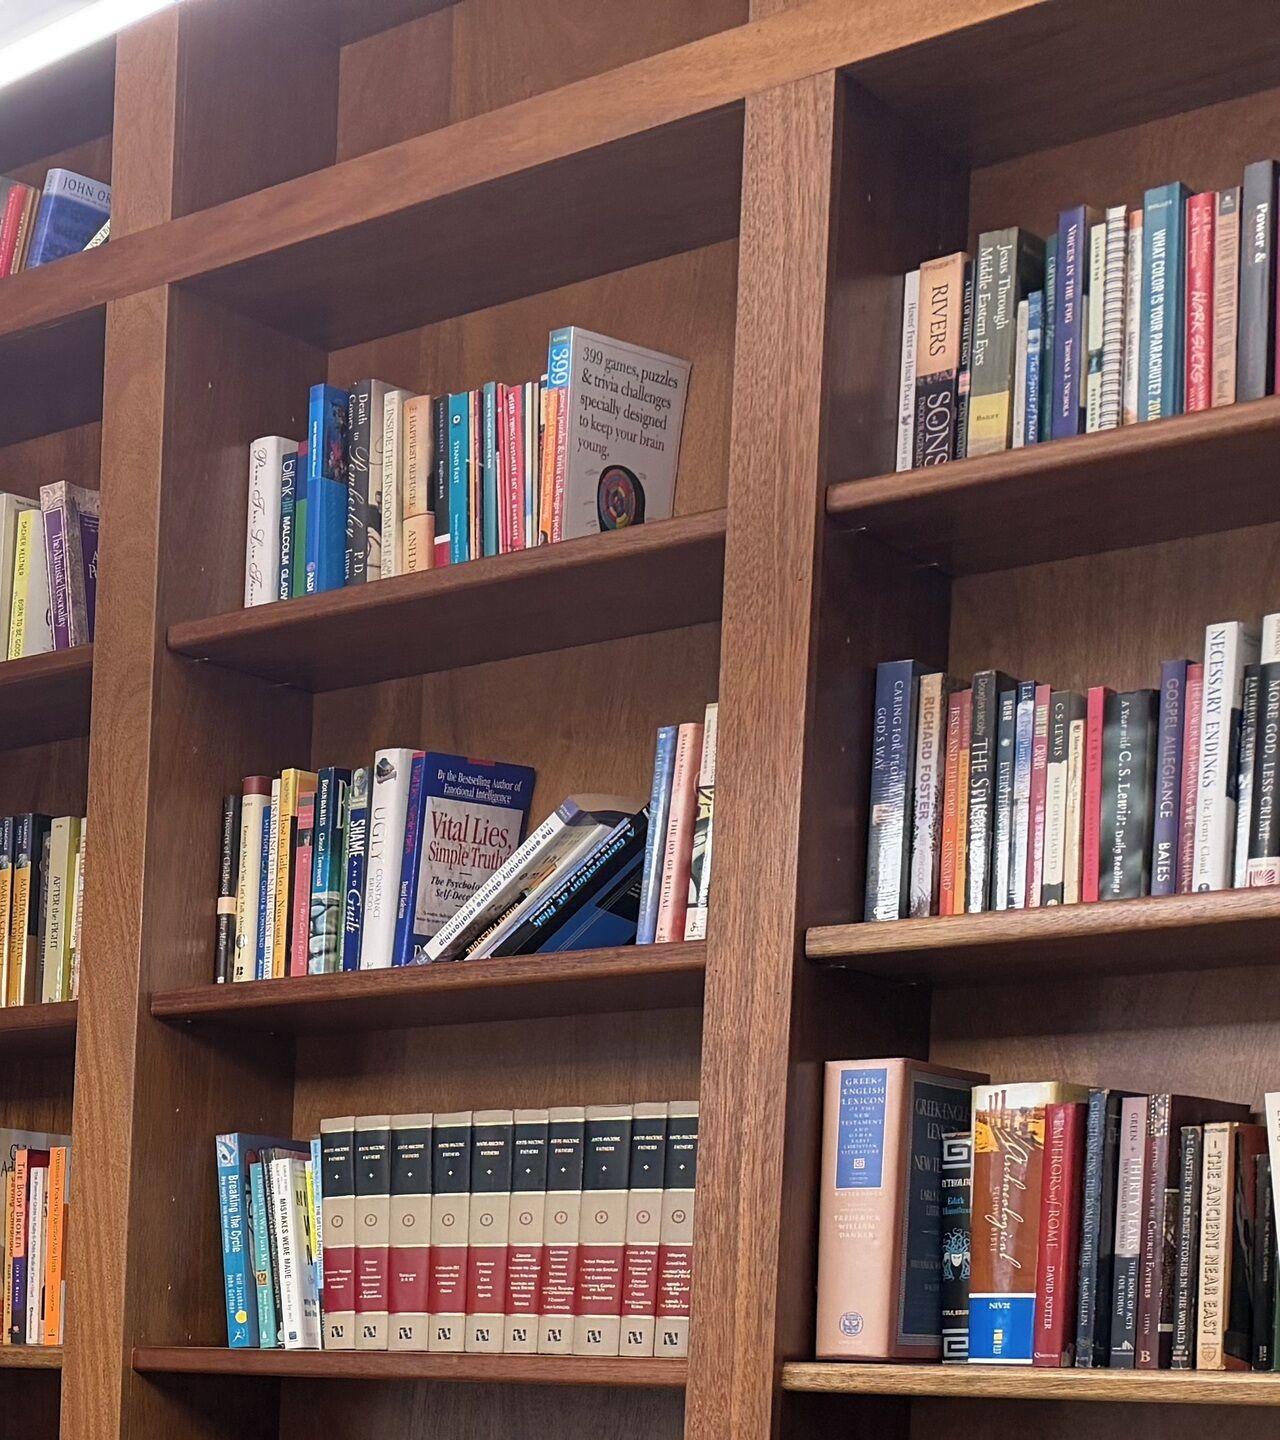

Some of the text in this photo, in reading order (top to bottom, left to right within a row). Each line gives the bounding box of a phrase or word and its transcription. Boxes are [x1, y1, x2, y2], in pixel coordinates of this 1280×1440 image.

[973, 247, 994, 366] Middle Eastern Eyes
[993, 244, 1013, 330] Jesus Through
[930, 283, 948, 357] RIVERS
[551, 348, 568, 385] 399
[583, 347, 678, 389] 399 games, puzzles
[580, 393, 667, 430] specially designed
[582, 368, 671, 411] & trivia challenges
[577, 437, 610, 460] young.
[579, 414, 664, 451] to keep your brain
[924, 391, 951, 467] SONS
[281, 459, 295, 565] blink MALCOLM
[1202, 629, 1226, 788] NECESSARY ENDINGS
[1266, 680, 1280, 719] MORE
[919, 696, 935, 821] RICHARD FOSTER
[1261, 762, 1275, 792] LESS
[349, 819, 365, 858] SHAME
[371, 807, 386, 860] UGLY
[432, 810, 512, 855] Vital Lies,
[1258, 796, 1272, 841] CRIME
[428, 840, 470, 871] Simple
[346, 889, 361, 934] Guilt
[228, 1175, 241, 1253] Breaking the Cycle
[1203, 1151, 1221, 1336] THE ANCIENT NEAR EAST
[1044, 1264, 1055, 1329] DAVID POTTER
